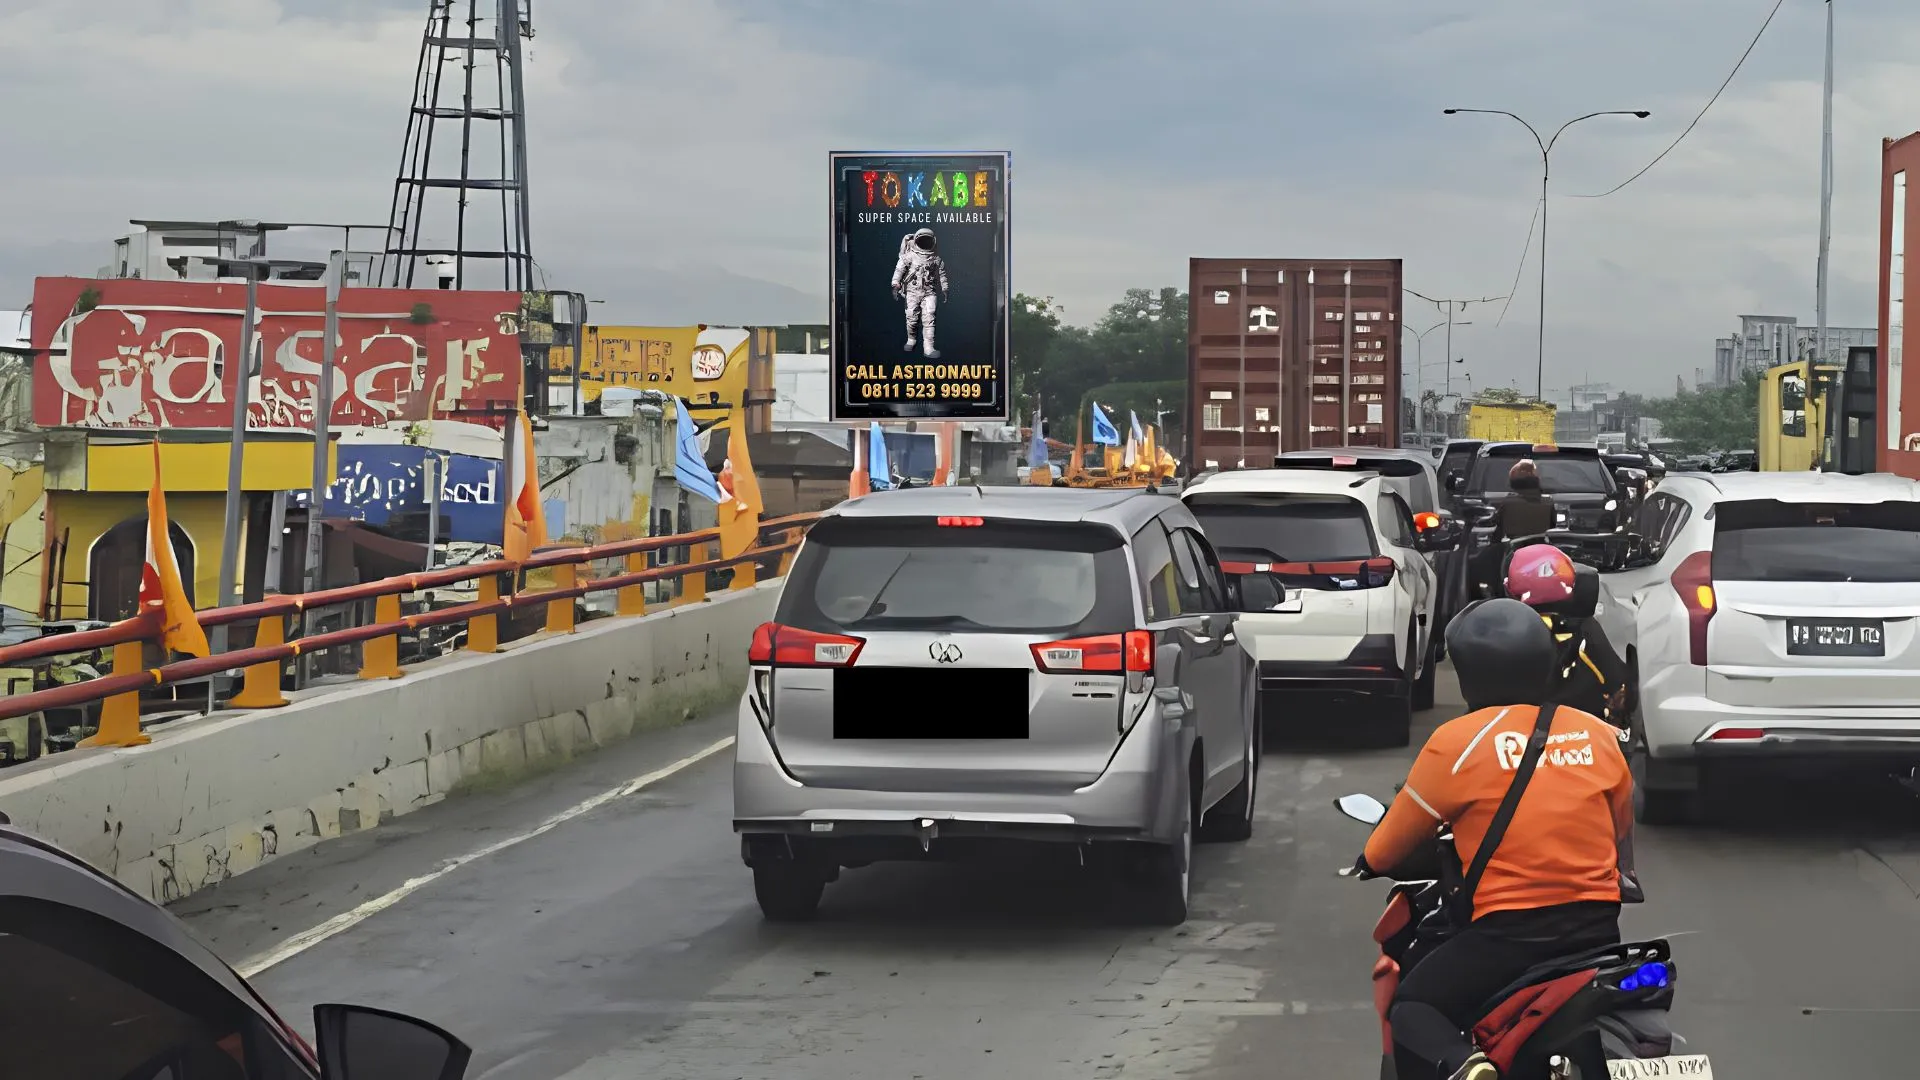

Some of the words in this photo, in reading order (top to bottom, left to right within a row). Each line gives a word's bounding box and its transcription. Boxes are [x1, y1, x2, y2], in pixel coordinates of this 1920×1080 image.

[862, 171, 988, 208] TOKABE
[858, 212, 892, 223] SUPER
[898, 212, 931, 223] SPACE
[936, 212, 992, 223] AVAILABLE
[845, 364, 887, 380] CALL
[892, 364, 997, 380] ASTRONAUT:
[861, 383, 899, 398] 0811
[906, 383, 936, 398] 523
[941, 383, 982, 398] 9999
